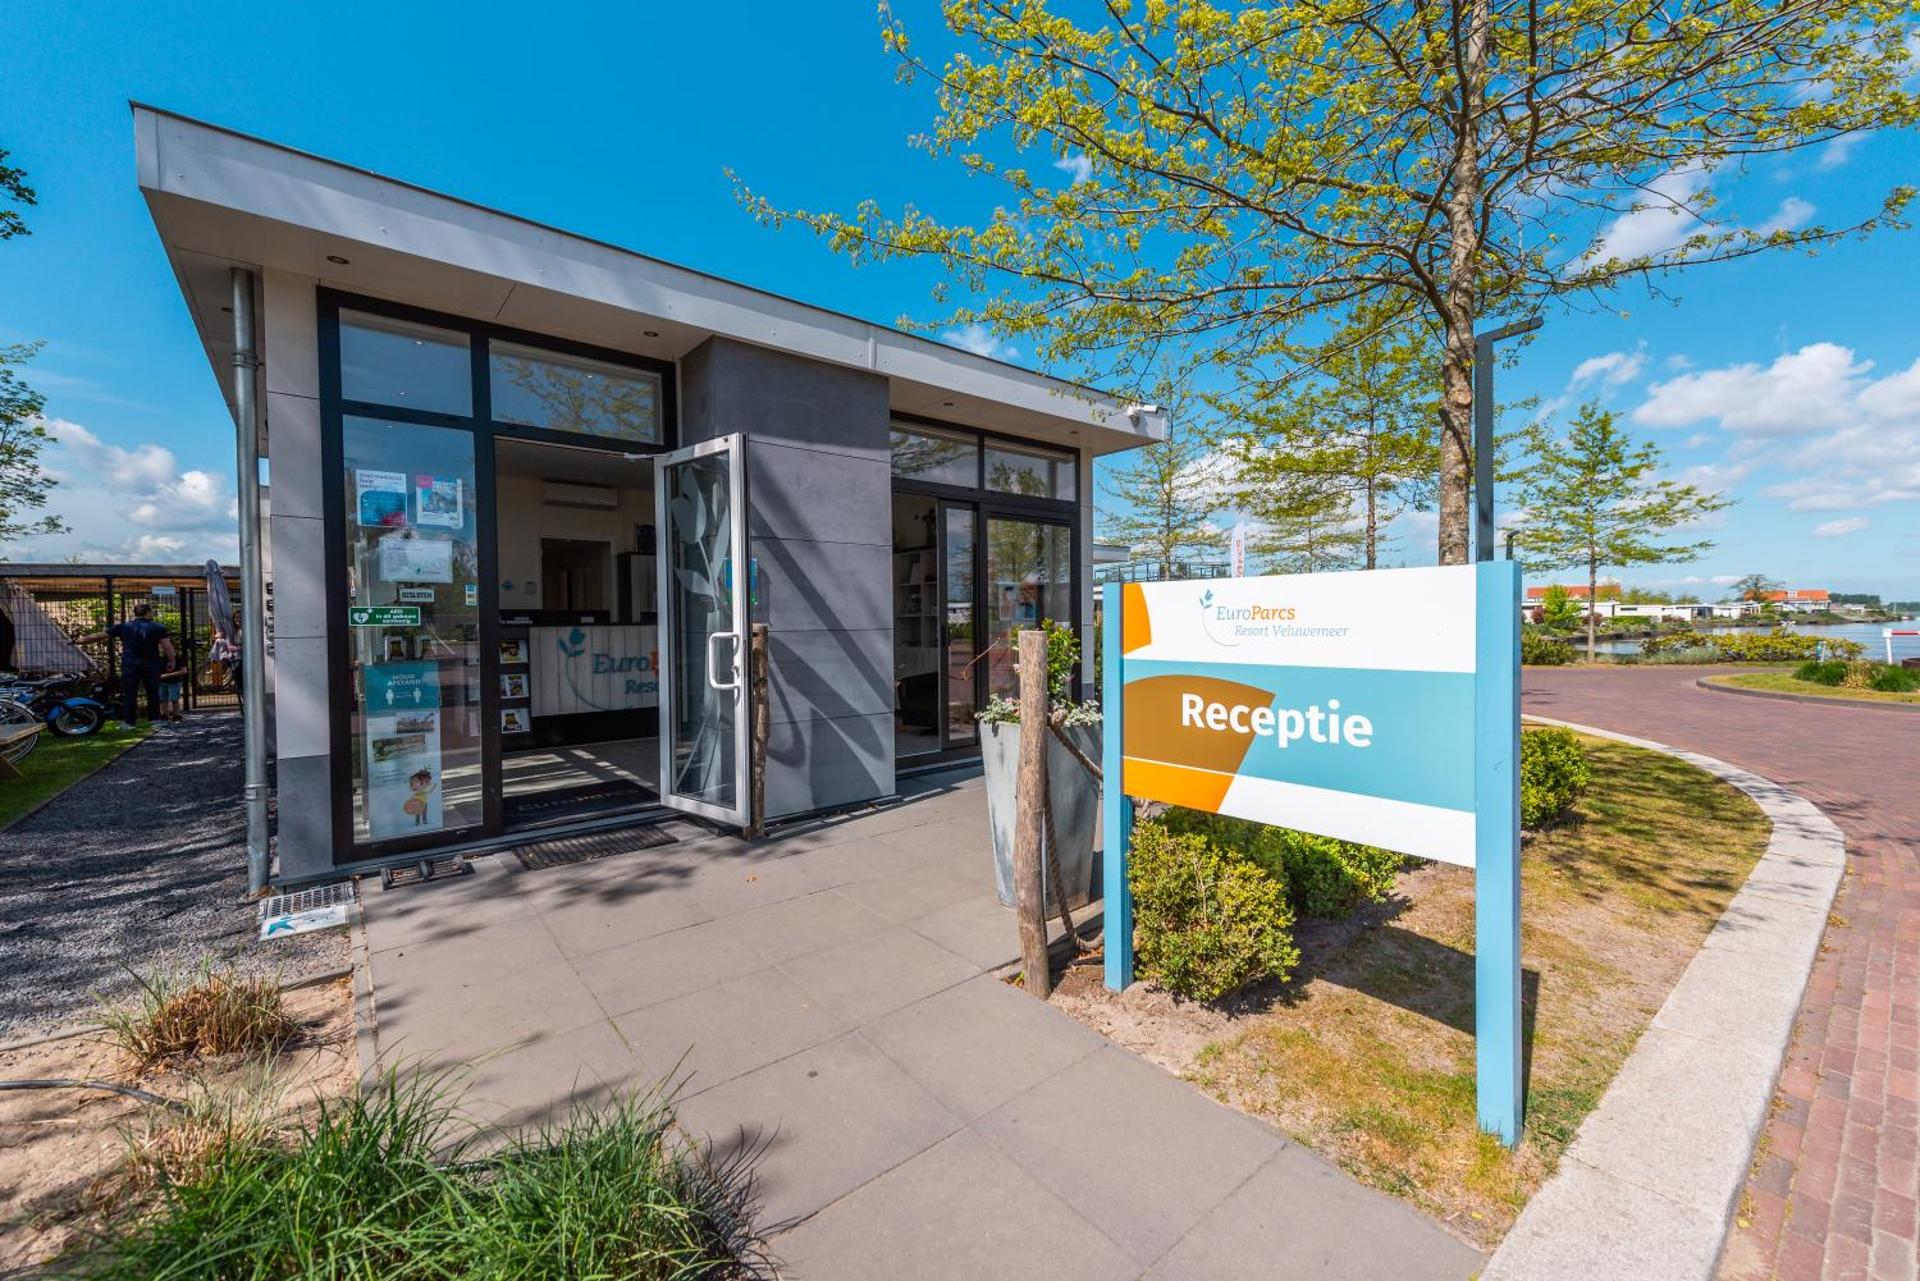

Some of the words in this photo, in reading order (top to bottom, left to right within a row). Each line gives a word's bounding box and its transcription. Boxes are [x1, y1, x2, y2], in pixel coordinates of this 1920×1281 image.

[1216, 605, 1296, 620] EuroParcs
[1235, 625, 1269, 636] Resort
[1273, 624, 1348, 637] Veluwemeer
[1181, 693, 1373, 748] Receptie
